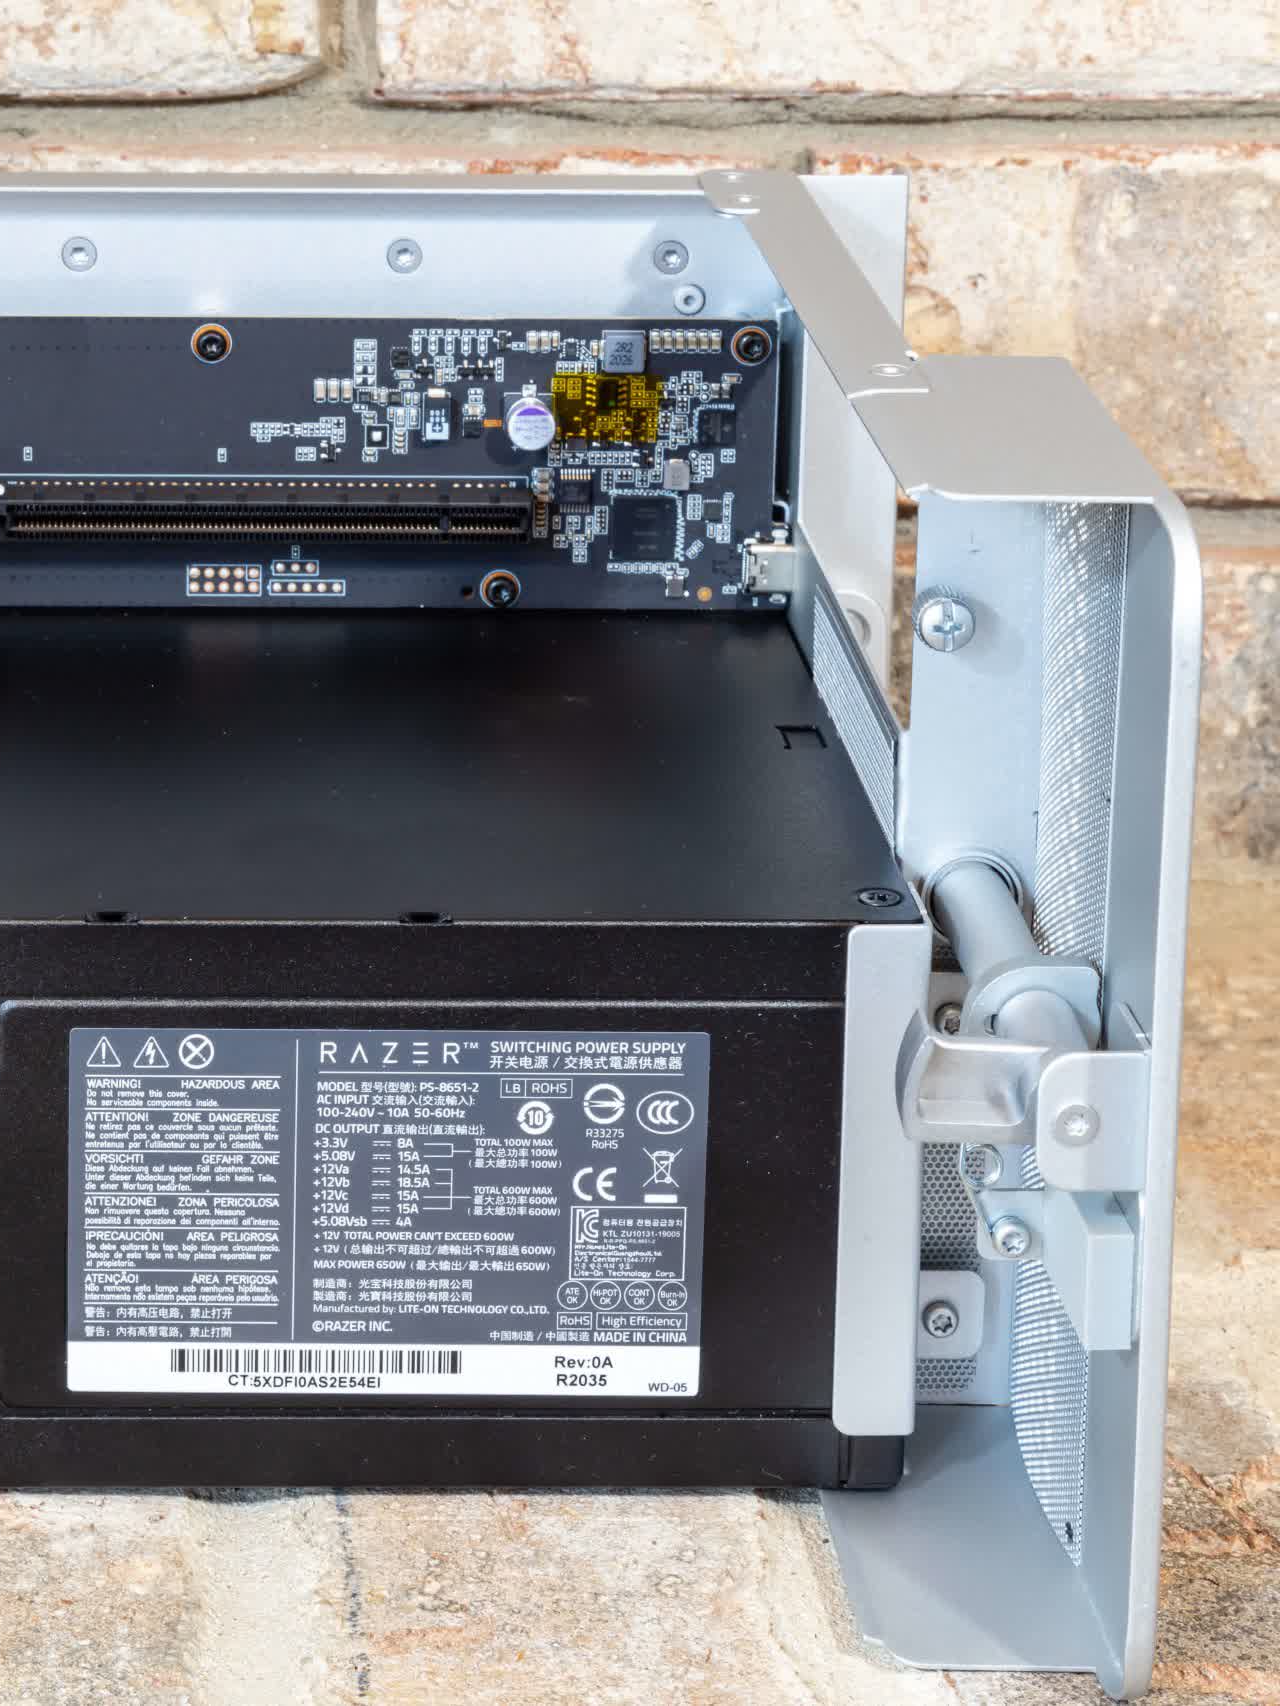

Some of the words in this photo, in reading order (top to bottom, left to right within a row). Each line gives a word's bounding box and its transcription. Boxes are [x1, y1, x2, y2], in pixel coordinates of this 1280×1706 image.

[490, 1041, 571, 1052] SWITCHING
[575, 1042, 628, 1053] POWER
[632, 1042, 686, 1053] SUPPLY
[86, 1078, 141, 1089] WARNING!
[181, 1079, 245, 1089] HAZARDOUS
[251, 1080, 280, 1089] AREA
[317, 1081, 358, 1091] MODEL
[419, 1082, 479, 1092] PS-8651-2
[505, 1084, 520, 1093] LB
[531, 1084, 567, 1093] ROHS
[316, 1094, 331, 1104] AC
[334, 1094, 369, 1104] INPUT
[84, 1112, 149, 1121] ATTENTION!
[172, 1112, 202, 1122] ZONE
[208, 1113, 279, 1122] DANGEREUSE
[316, 1107, 375, 1117] 100-240V
[387, 1107, 409, 1117] 10A
[414, 1108, 465, 1117] 50-60Hz
[315, 1124, 330, 1133] DC
[332, 1124, 380, 1133] OUTPUT
[585, 1128, 624, 1137] R33275
[313, 1138, 348, 1148] +3.3V
[396, 1138, 414, 1148] 8A
[591, 1140, 618, 1149] RoHS
[84, 1154, 143, 1163] VORSICHT!
[201, 1155, 243, 1164] GEFAHR
[250, 1155, 279, 1164] ZONE
[313, 1151, 355, 1161] +5.08V
[397, 1151, 420, 1161] 15A
[312, 1164, 349, 1174] +12Va
[397, 1164, 430, 1174] 14.5A
[530, 1160, 562, 1168] 100W)
[312, 1177, 350, 1187] +12Vb
[397, 1177, 430, 1187] 18.5A
[572, 1167, 617, 1201] CE
[312, 1190, 348, 1200] +12Vc
[396, 1190, 419, 1200] 15A
[84, 1196, 156, 1206] ATTENZIONE!
[178, 1197, 207, 1206] ZONA
[213, 1197, 279, 1207] PERICOLOSA
[312, 1203, 349, 1213] +12Vd
[396, 1203, 419, 1213] 15A
[528, 1208, 560, 1216] 600W)
[312, 1216, 367, 1226] +5.08Vsb
[395, 1216, 412, 1226] 4A
[186, 1231, 215, 1241] AREA
[220, 1232, 279, 1241] PELIGROSA
[343, 1231, 373, 1239] TOTAL
[375, 1231, 412, 1240] POWER
[444, 1232, 481, 1240] EXCEED
[521, 1246, 555, 1256] 600W)
[313, 1260, 336, 1269] MAX
[338, 1260, 375, 1269] POWER
[376, 1260, 406, 1269] 650W
[515, 1262, 550, 1272] 650W)
[225, 1274, 278, 1285] PERIGOSA
[565, 1288, 580, 1296] ATE
[312, 1304, 380, 1312] Manufactured
[382, 1304, 396, 1314] by:
[398, 1304, 439, 1313] LITE-ON
[440, 1304, 508, 1313] TECHNOLOGY
[559, 1315, 591, 1325] RoHS
[602, 1316, 626, 1328] High
[630, 1316, 682, 1328] Efficiency
[368, 1320, 392, 1331] INC.
[593, 1331, 630, 1342] MADE
[632, 1332, 645, 1342] IN
[648, 1332, 686, 1342] CHINA
[554, 1356, 613, 1368] Rev:0A
[556, 1374, 607, 1386] R2035
[647, 1382, 687, 1392] WD-05
